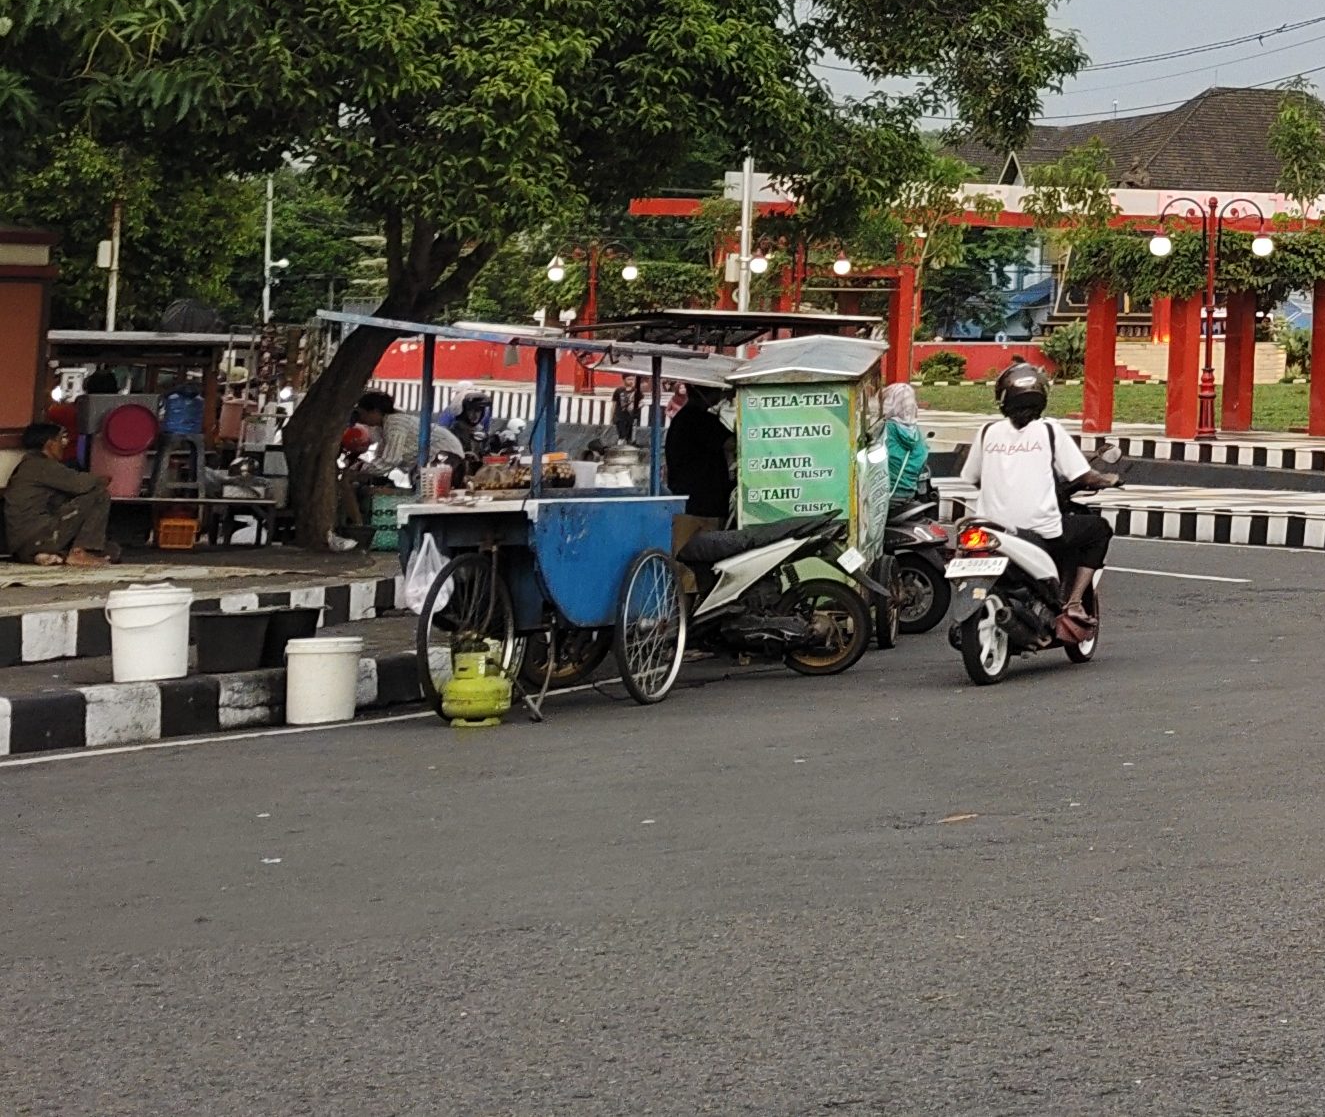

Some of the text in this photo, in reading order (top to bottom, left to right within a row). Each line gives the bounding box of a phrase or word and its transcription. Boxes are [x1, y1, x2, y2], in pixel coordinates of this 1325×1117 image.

[761, 394, 841, 408] TELA-TELA
[761, 424, 831, 438] KENTANG
[761, 457, 812, 469] JAMUR
[793, 469, 833, 479] CRISPY
[761, 488, 801, 500] TAHU
[793, 503, 833, 512] CRISPY
